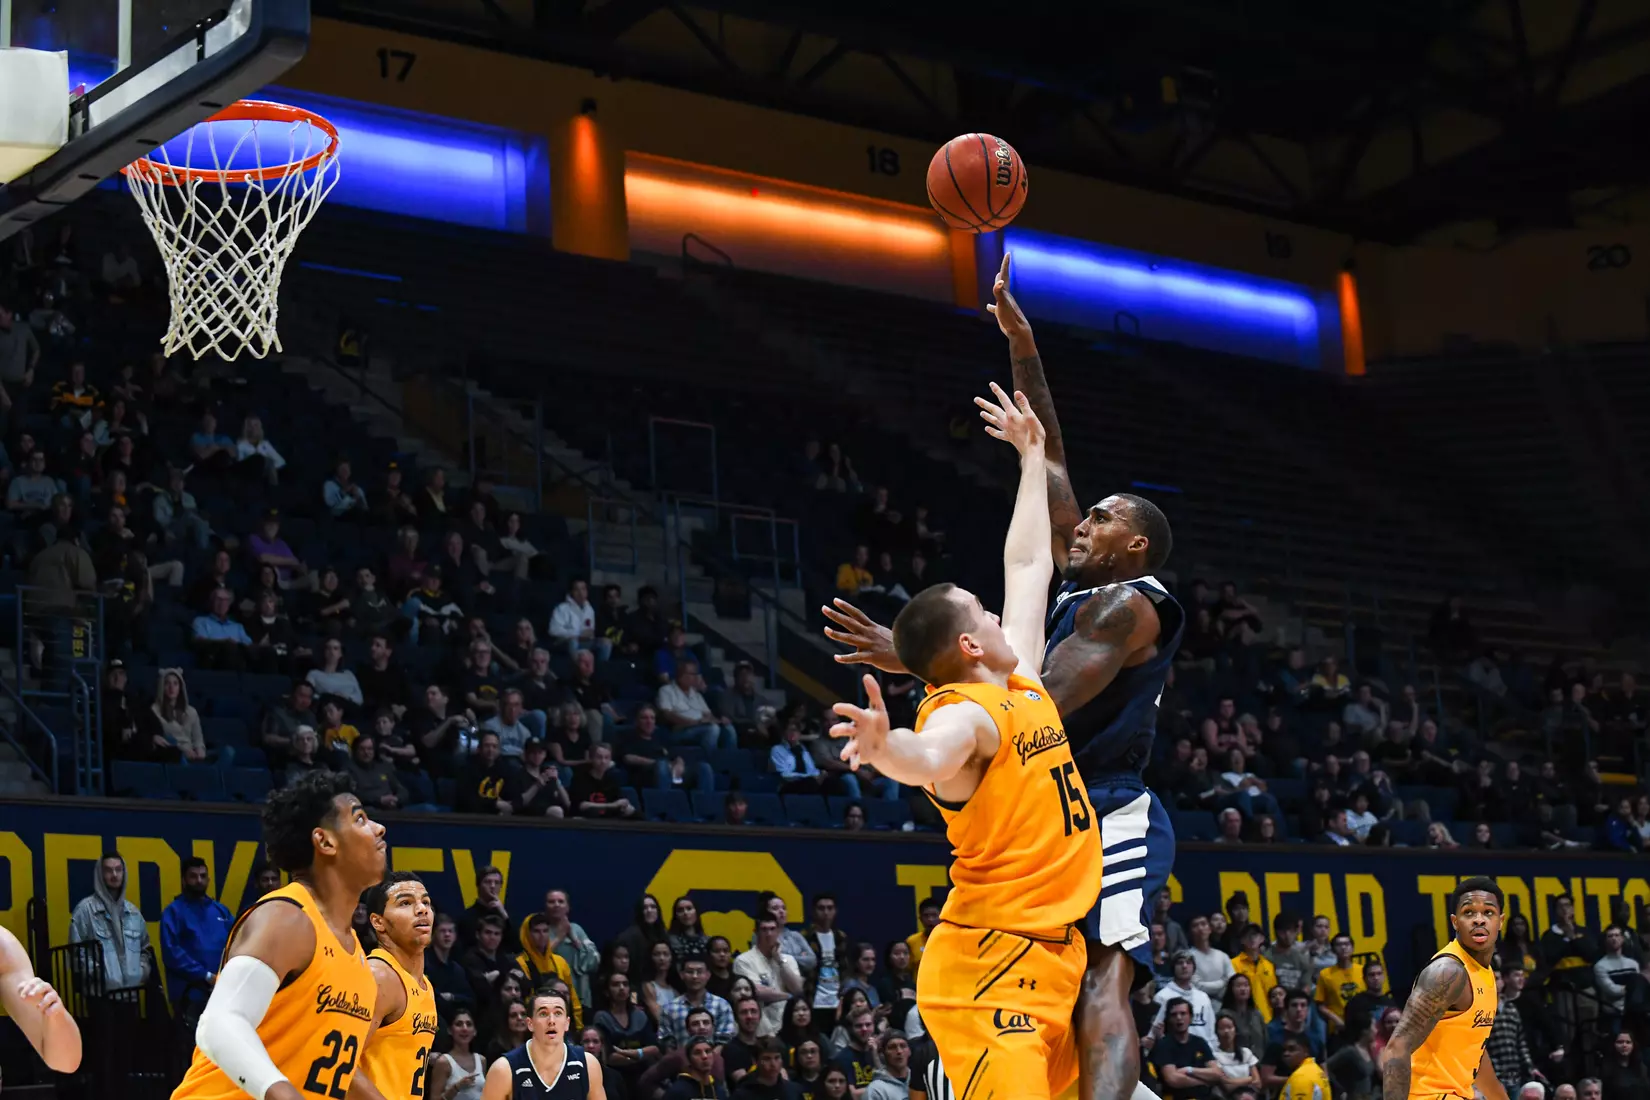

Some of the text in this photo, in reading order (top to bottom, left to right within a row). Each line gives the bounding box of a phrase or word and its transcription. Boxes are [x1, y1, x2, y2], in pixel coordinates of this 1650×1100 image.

[376, 47, 417, 82] 17
[867, 145, 900, 176] 18
[1586, 244, 1631, 271] 20
[1049, 761, 1091, 837] 15
[316, 984, 351, 1014] Golden
[993, 1008, 1037, 1037] Cal
[304, 1029, 358, 1100] 22
[567, 1073, 581, 1081] WAC
